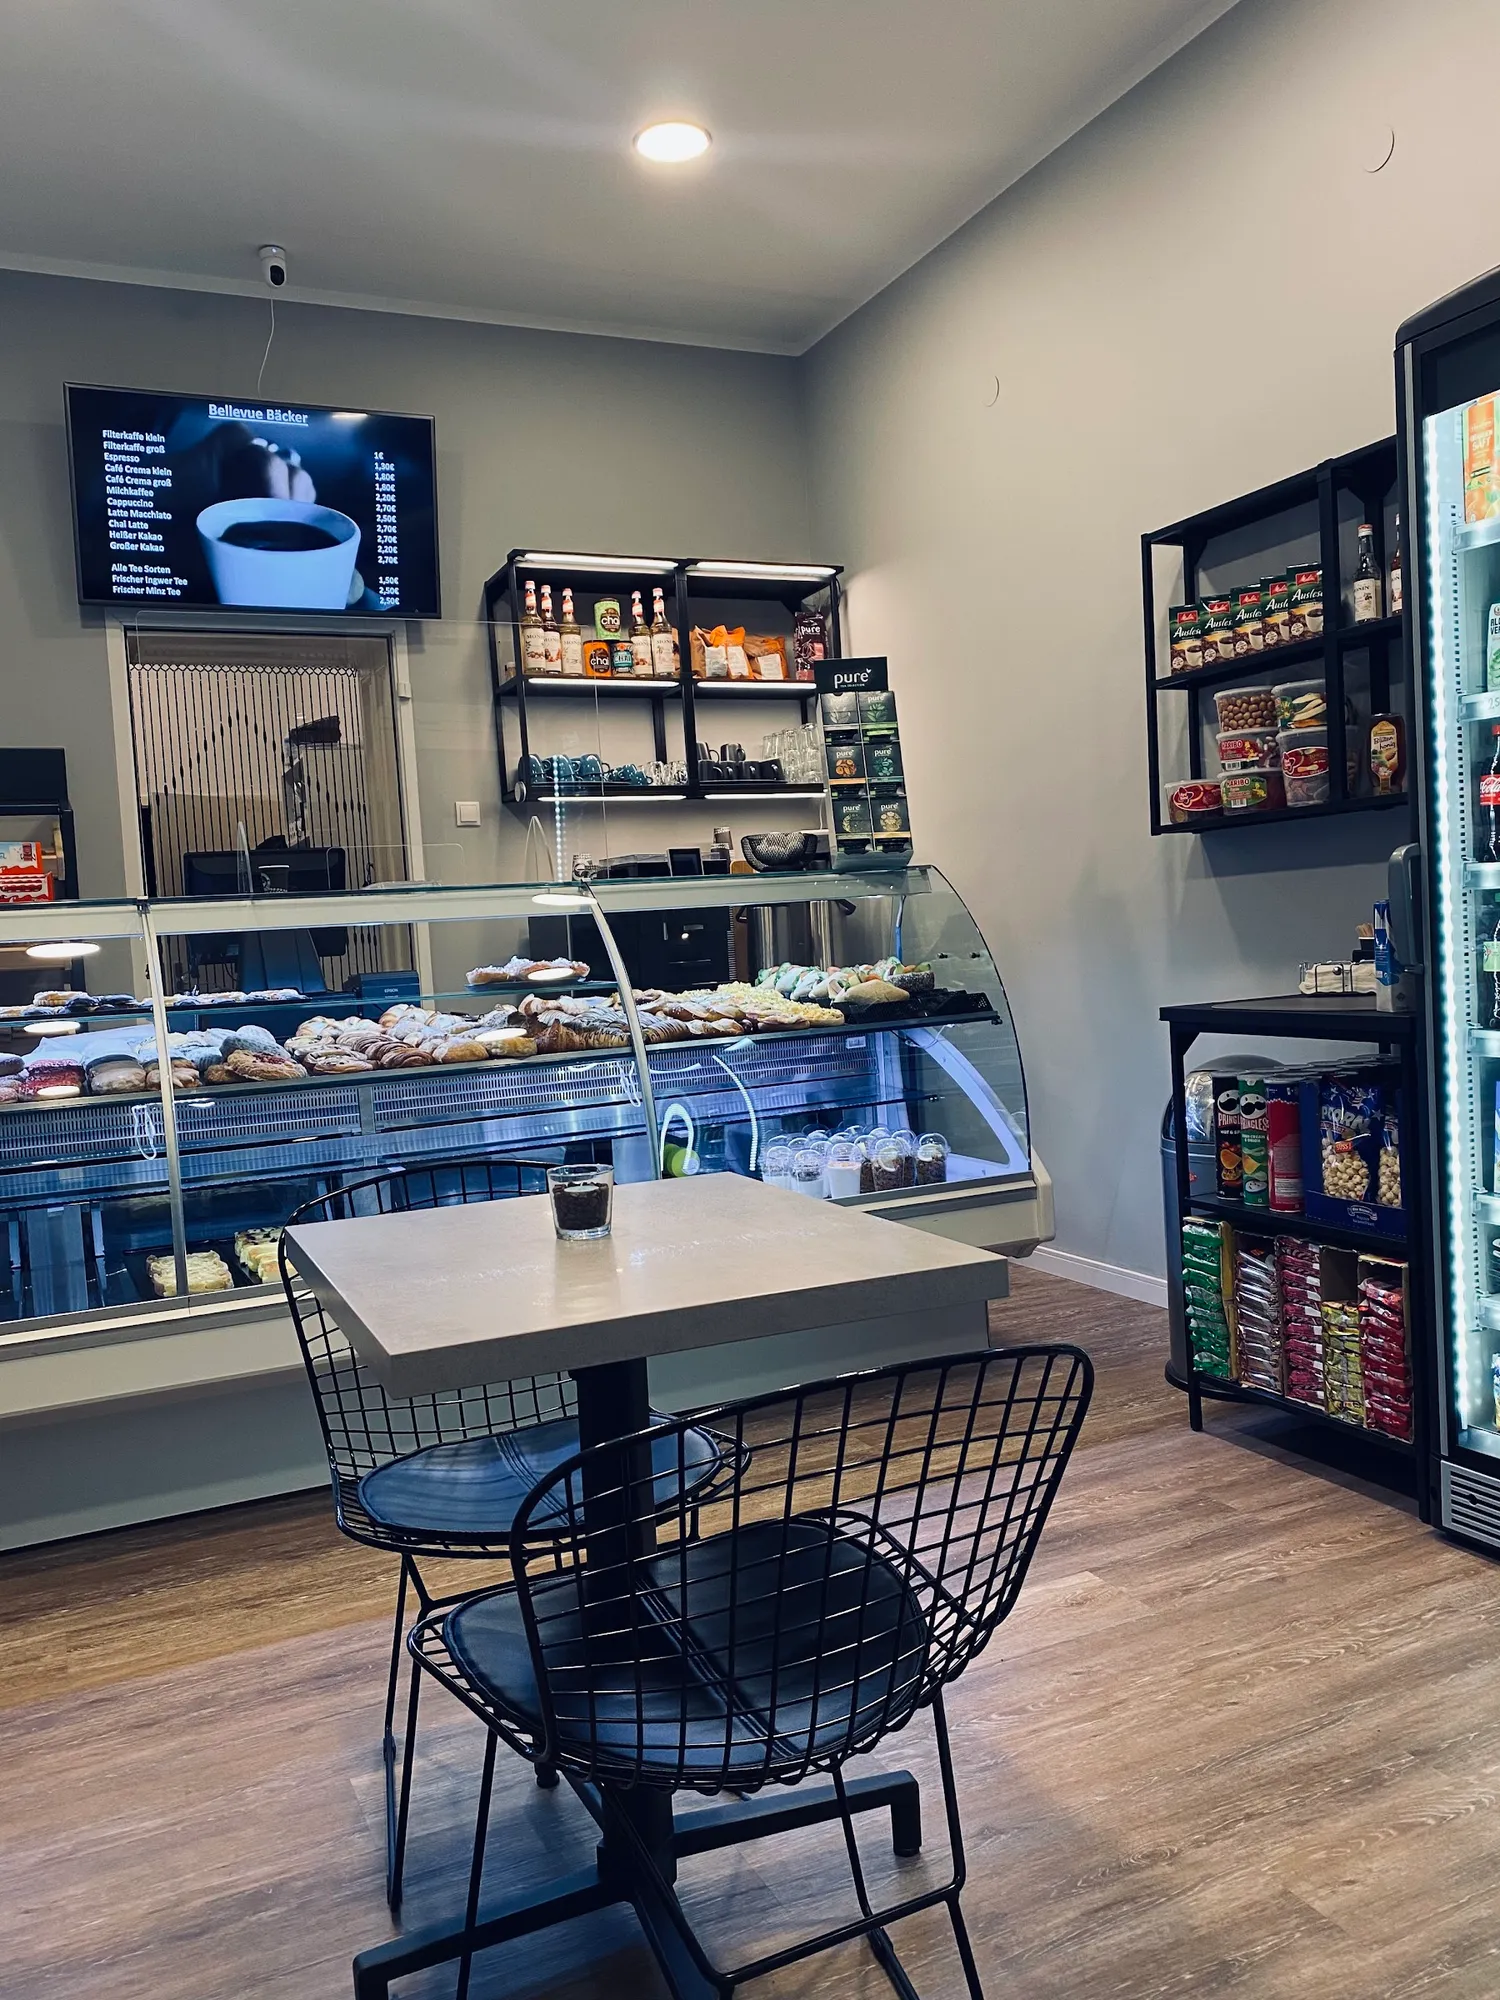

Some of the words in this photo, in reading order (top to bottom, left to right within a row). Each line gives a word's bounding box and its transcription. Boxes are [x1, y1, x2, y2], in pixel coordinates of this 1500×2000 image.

[208, 403, 264, 420] Bellevue
[266, 408, 309, 424] Bäcker
[102, 429, 144, 441] Filterkaffe
[145, 432, 166, 443] klein
[103, 441, 145, 452] Filterkaffe
[145, 445, 166, 454] groß
[103, 452, 140, 463] Espresso
[373, 451, 384, 460] 1€
[104, 463, 124, 473] Café
[124, 465, 151, 475] Crema
[152, 466, 172, 477] klein
[105, 474, 124, 484] Café
[125, 476, 152, 486] Crema
[152, 478, 172, 488] groß
[106, 486, 154, 497] Milchkaffee
[106, 497, 154, 508] Cappuccino
[375, 493, 397, 503] 2,20€
[375, 503, 397, 513] 2,70€
[107, 508, 129, 517] Latte
[129, 509, 172, 520] Macchiato
[376, 514, 397, 523] 2,50€
[108, 519, 127, 529] Chai
[128, 520, 149, 530] Latte
[376, 524, 398, 534] 2,70€
[109, 530, 138, 540] Heißer
[138, 531, 163, 541] Kakao
[377, 534, 398, 544] 2,70€
[109, 541, 139, 551] Großer
[139, 542, 165, 552] Kakao
[377, 545, 398, 555] 2,20€
[377, 555, 399, 565] 2,70€
[111, 563, 128, 572] Alle
[128, 564, 143, 573] Tee
[143, 564, 171, 574] Sorten
[112, 574, 144, 584] Frischer
[144, 576, 173, 586] Ingwer
[173, 577, 188, 586] Tee
[378, 576, 399, 585] 1,50€
[112, 585, 145, 595] Frischer
[145, 586, 166, 596] Minz
[166, 587, 182, 596] Tee
[378, 586, 400, 596] 2,50€
[1205, 617, 1232, 629] Ausles
[801, 625, 821, 636] pure
[834, 671, 869, 689] pure
[836, 750, 853, 758] pure
[874, 748, 891, 757] pure
[842, 804, 860, 813] pure
[880, 803, 898, 812] pure
